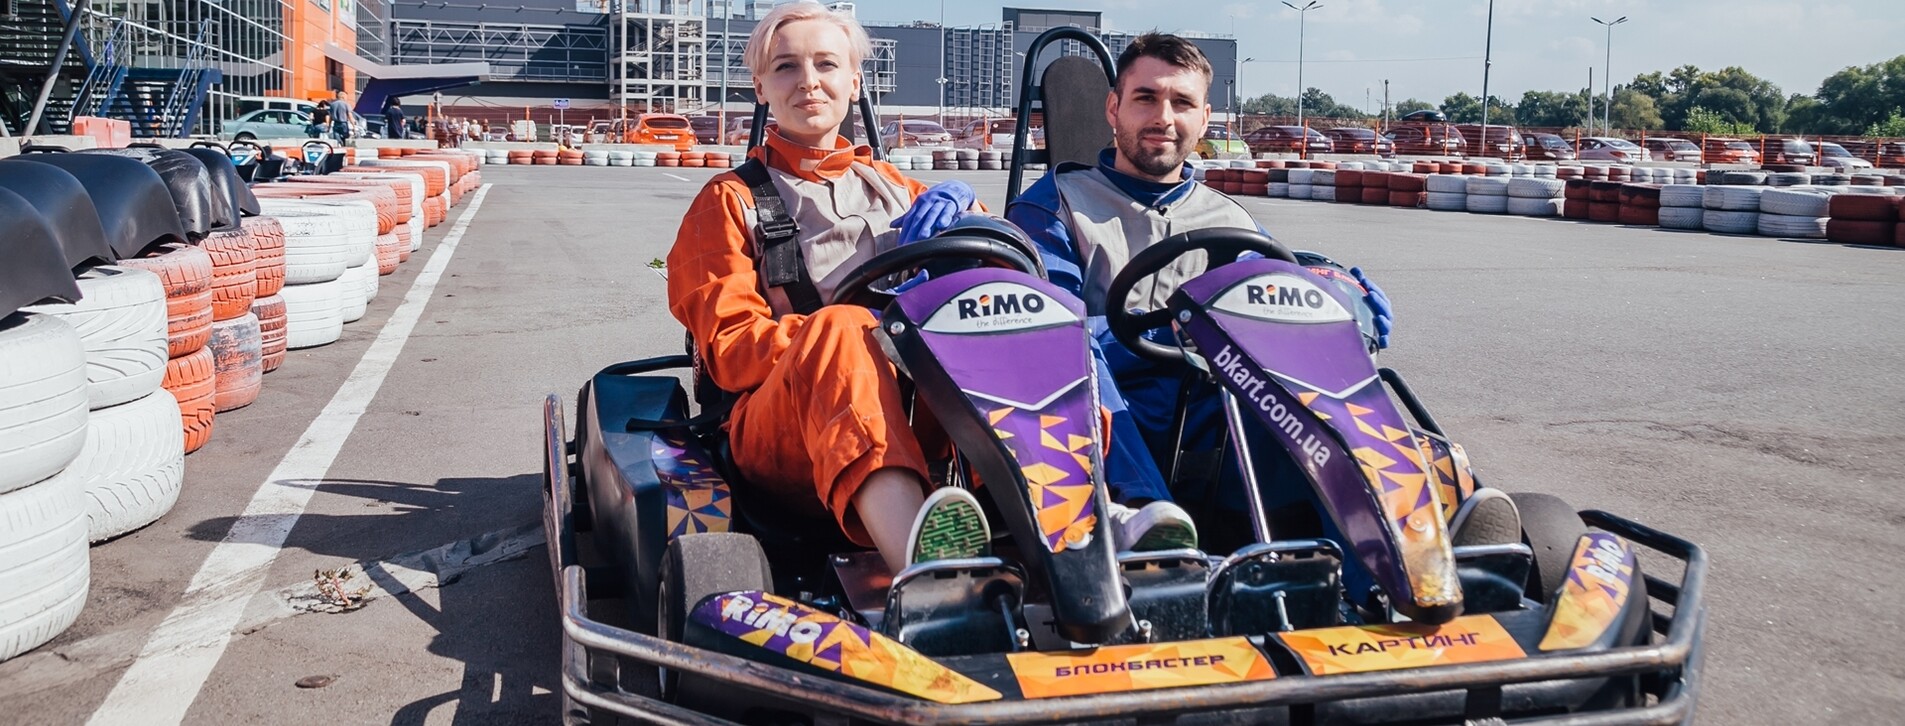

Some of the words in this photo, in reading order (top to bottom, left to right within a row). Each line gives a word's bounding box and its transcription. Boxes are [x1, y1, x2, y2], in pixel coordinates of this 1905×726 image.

[976, 319, 990, 329] the
[993, 316, 1032, 327] difference
[1213, 344, 1331, 468] bkart.com.ua
[1328, 632, 1480, 656] КАРТИНГ
[1055, 654, 1226, 678] БЛОКБАСТЕР
